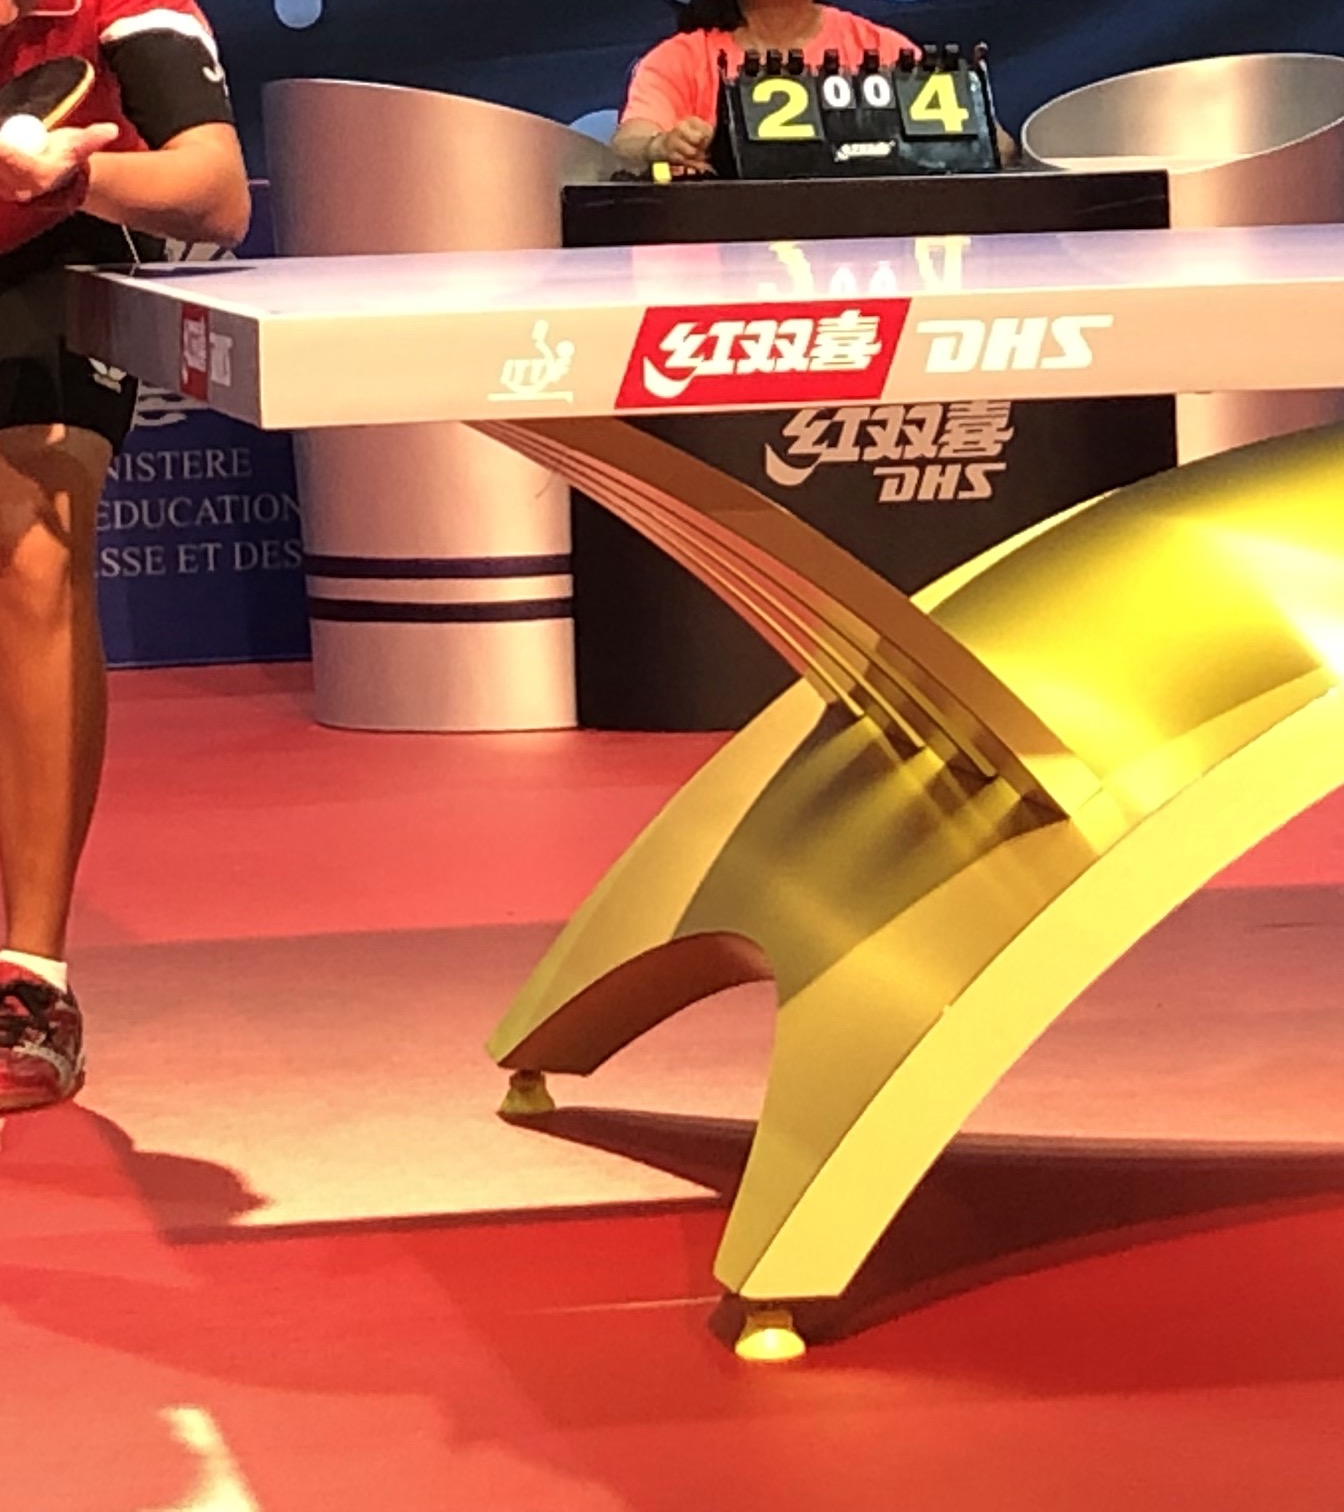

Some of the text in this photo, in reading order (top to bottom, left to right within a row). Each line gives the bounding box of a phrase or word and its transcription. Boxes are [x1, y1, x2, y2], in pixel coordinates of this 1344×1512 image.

[752, 78, 815, 138] 2
[910, 73, 969, 132] 4
[643, 310, 882, 399] 红双喜
[917, 314, 1114, 373] DHS
[764, 400, 1014, 486] 红双喜
[873, 462, 1007, 503] DHS
[177, 541, 223, 575] ET
[233, 539, 303, 571] DES
